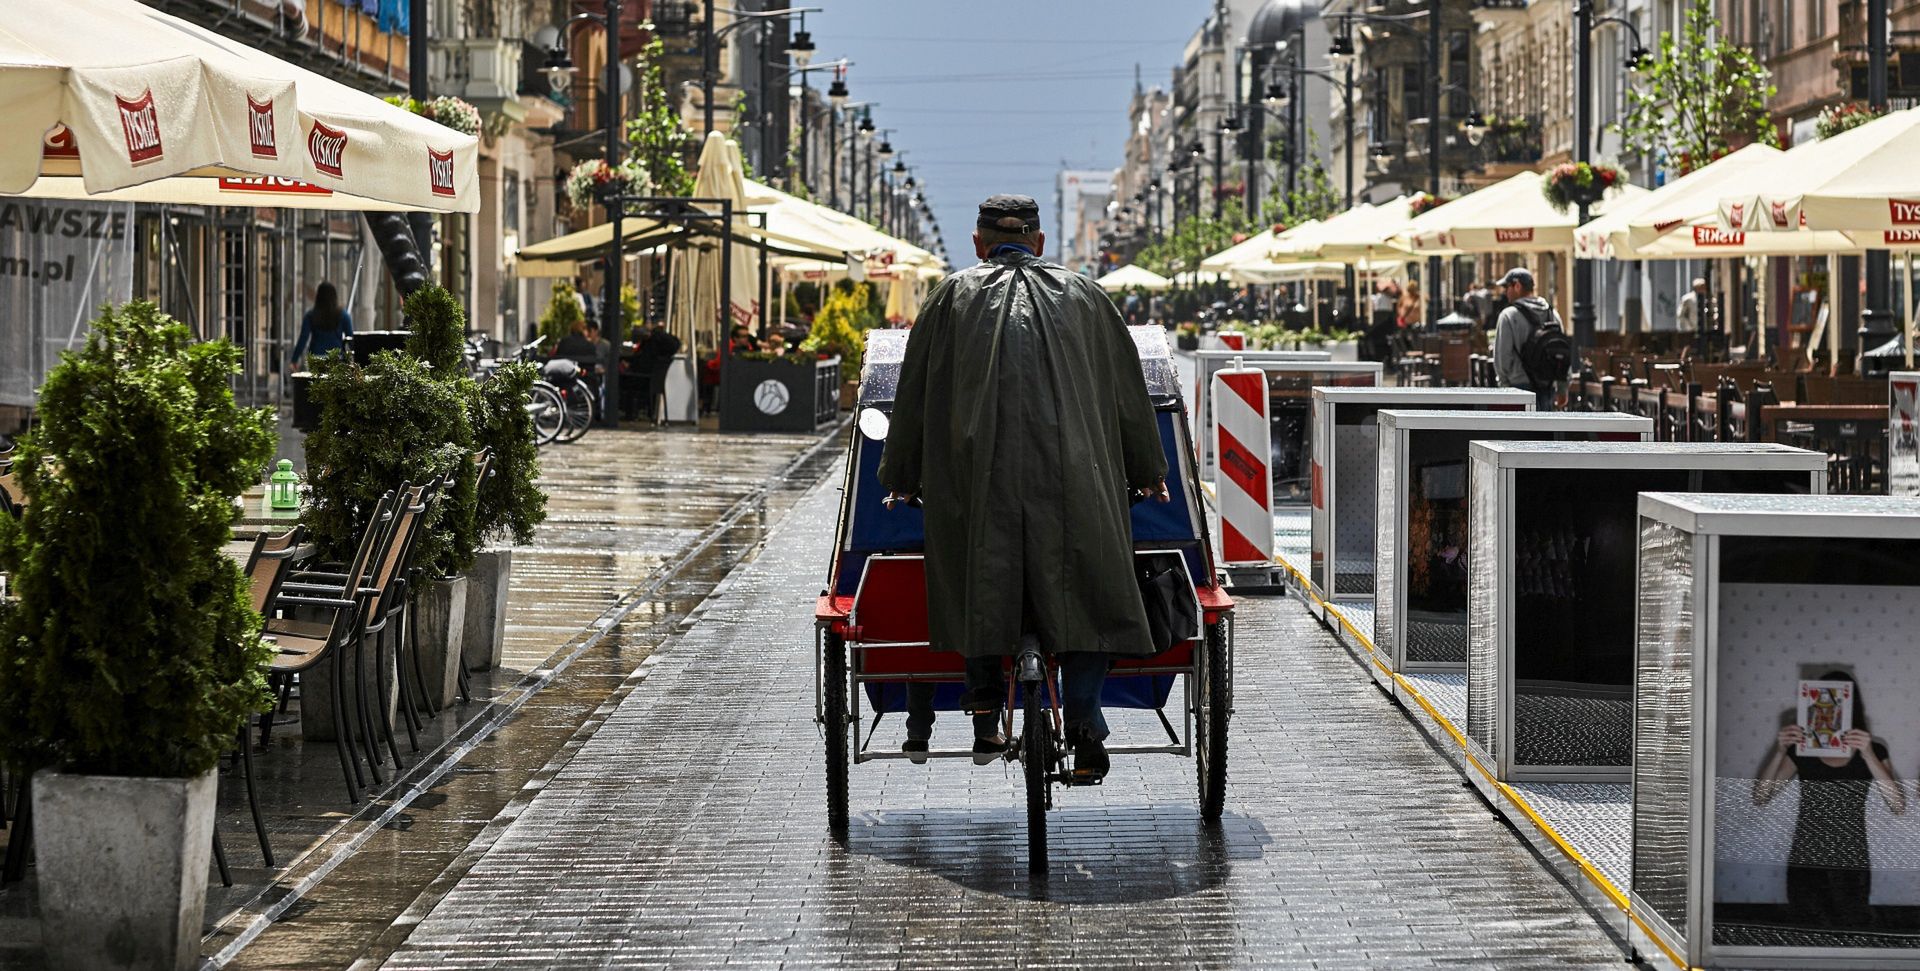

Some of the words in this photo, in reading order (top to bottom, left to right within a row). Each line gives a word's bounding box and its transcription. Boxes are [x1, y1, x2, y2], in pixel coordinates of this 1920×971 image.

[119, 102, 159, 151] TYSKIE
[250, 106, 274, 148] TYSKIE
[311, 128, 346, 168] TYSKIE
[430, 156, 453, 188] TYSKIE
